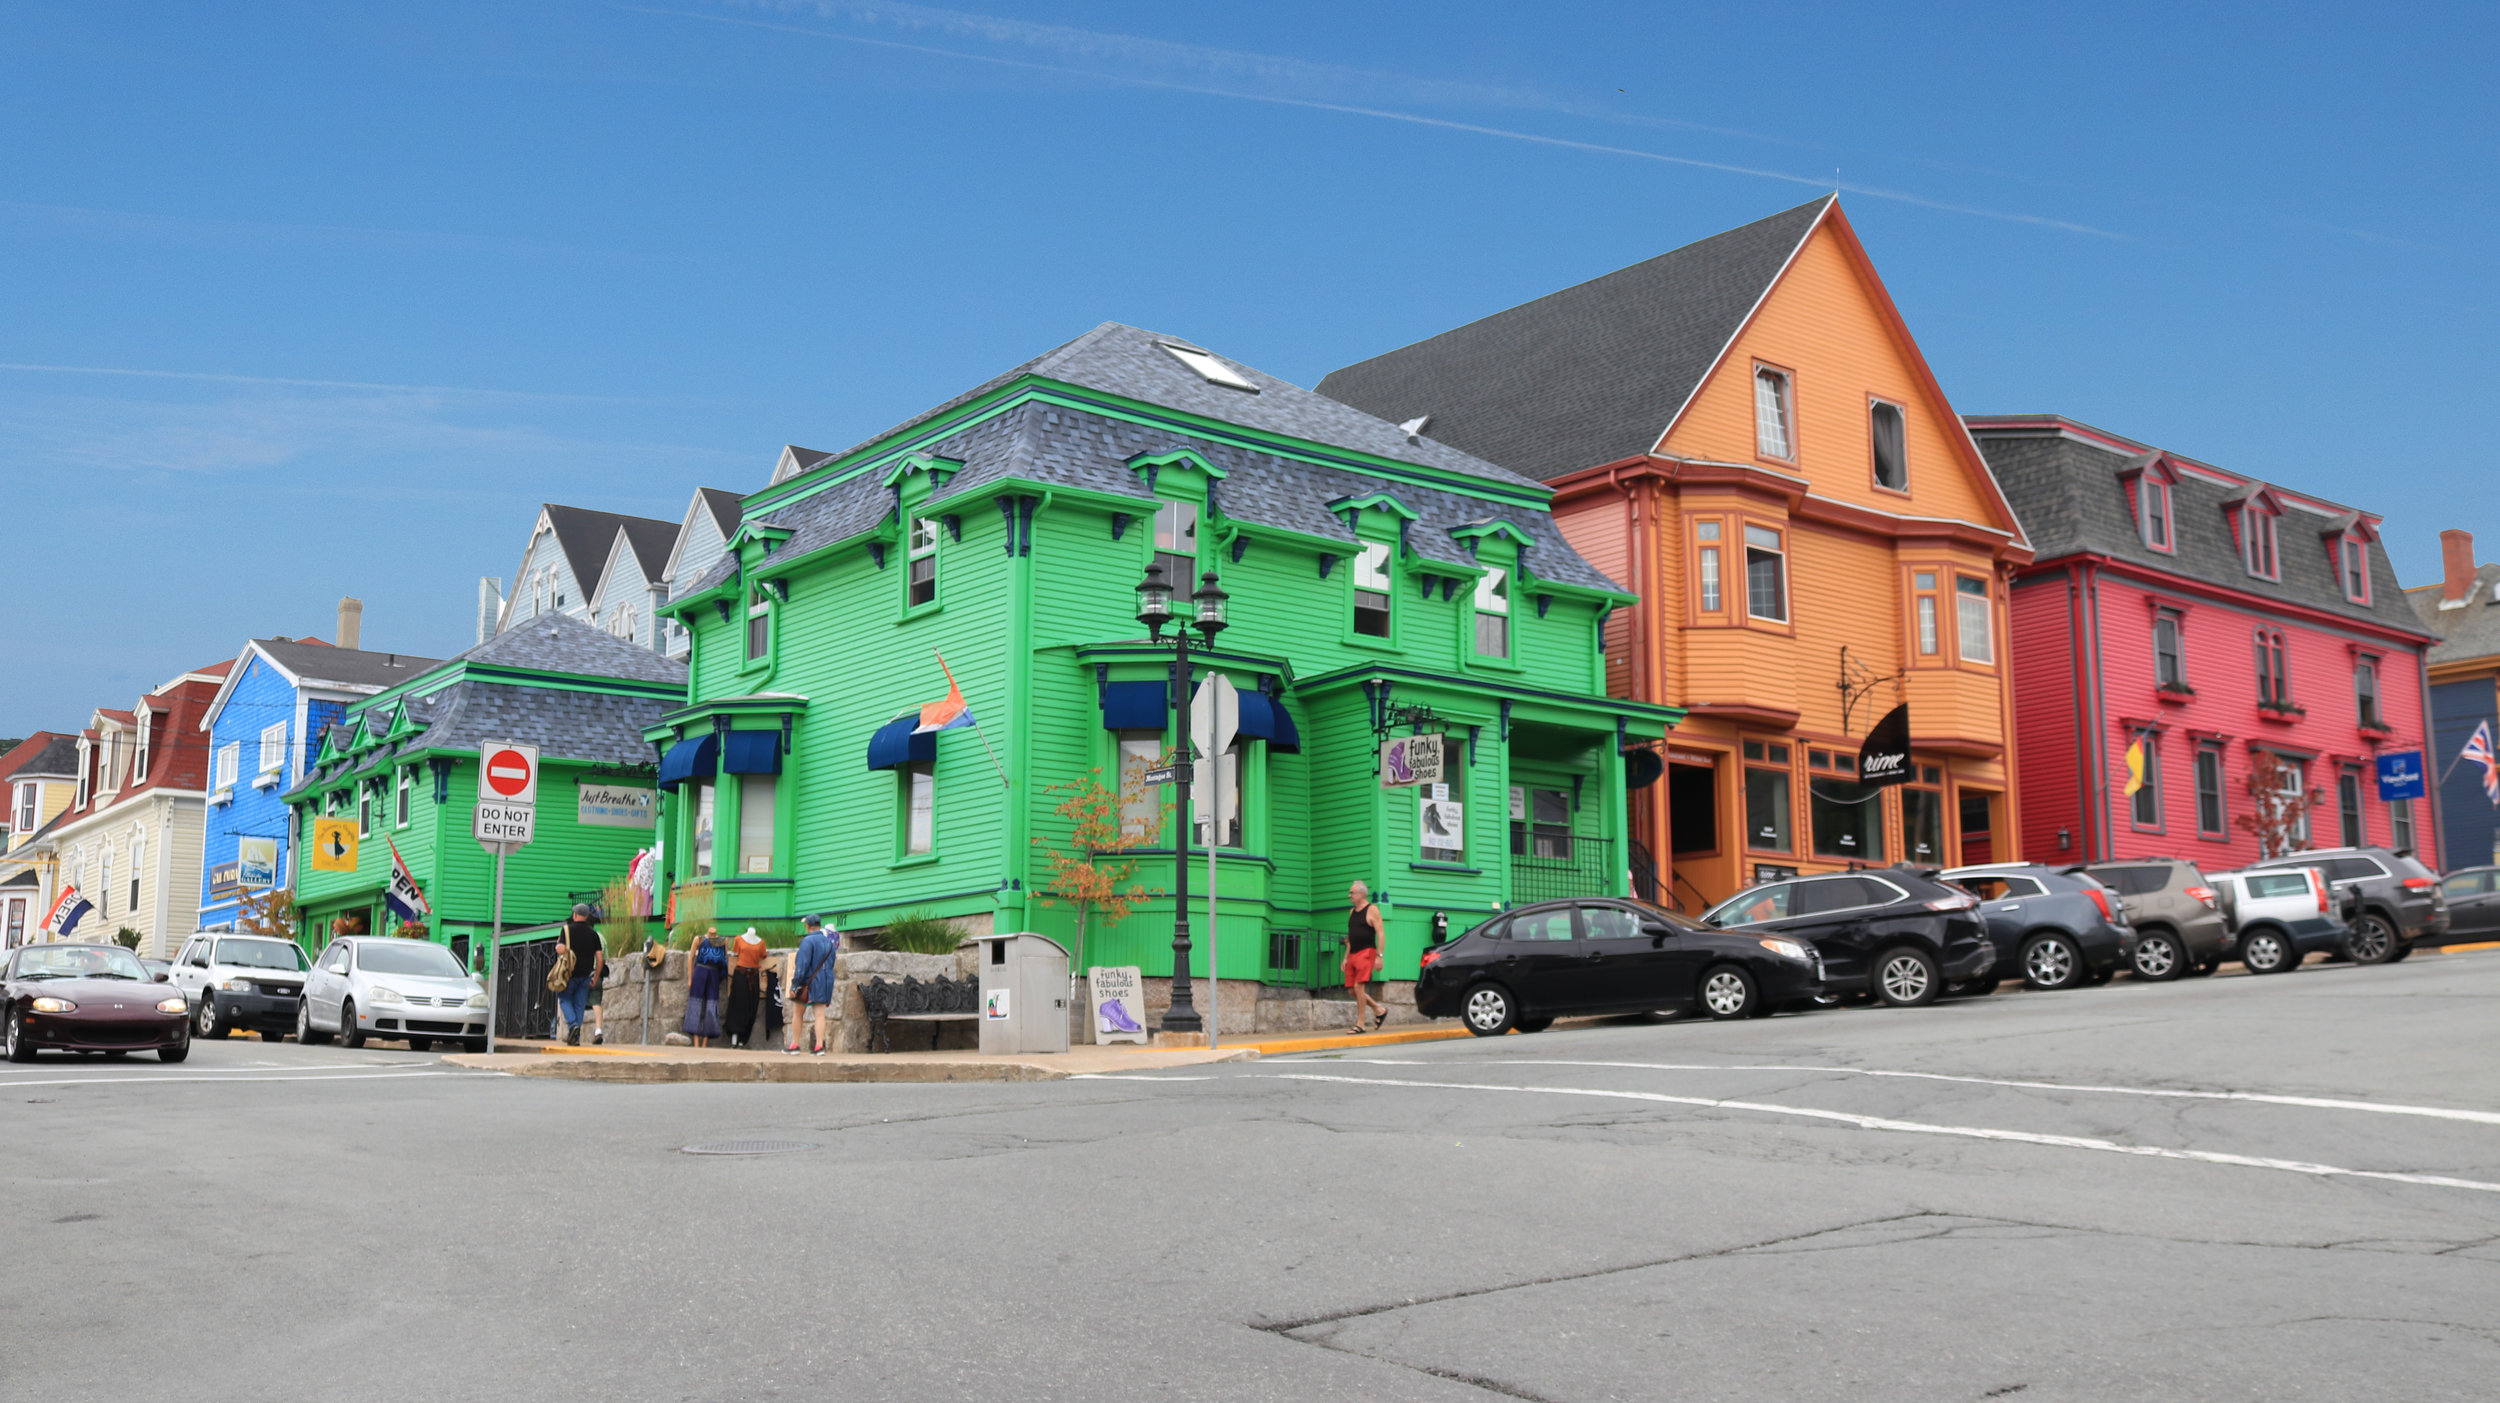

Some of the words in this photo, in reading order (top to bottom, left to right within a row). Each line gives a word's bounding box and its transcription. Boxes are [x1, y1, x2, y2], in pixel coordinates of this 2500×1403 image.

[1409, 755, 1440, 769] fabulous
[1863, 752, 1905, 772] rime
[1414, 768, 1437, 780] shoes
[580, 789, 600, 804] Just
[600, 791, 637, 806] Breathe
[481, 808, 501, 820] DO
[504, 810, 530, 823] NOT
[483, 823, 526, 838] ENTER
[391, 867, 420, 901] PEN
[1095, 978, 1133, 989] fabulous
[1099, 988, 1129, 998] shoes
